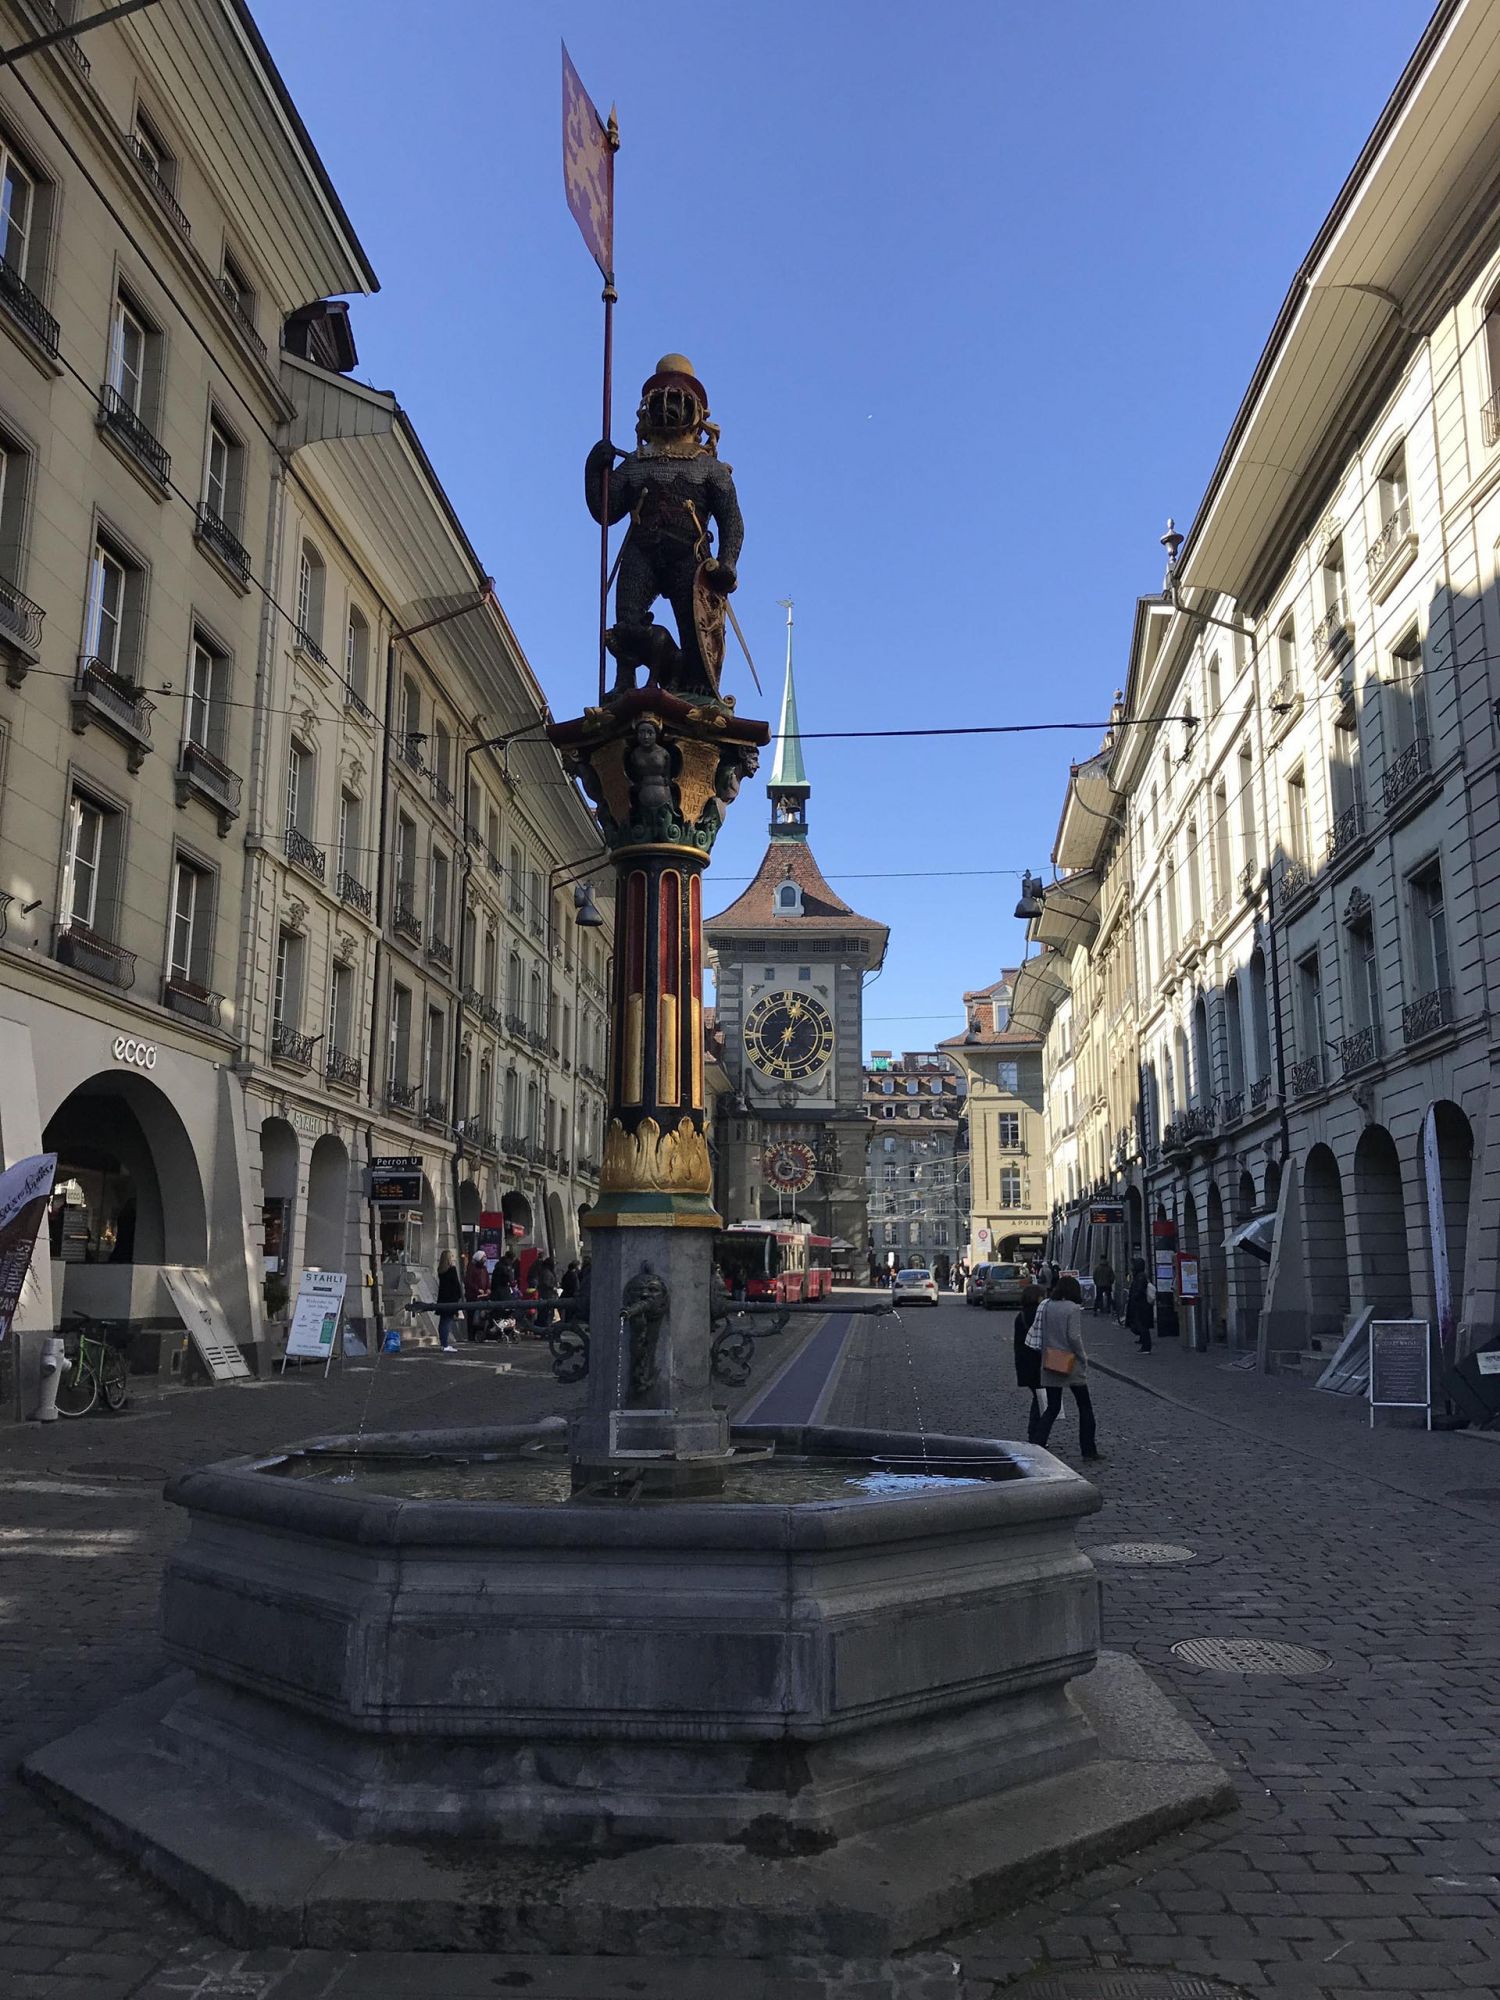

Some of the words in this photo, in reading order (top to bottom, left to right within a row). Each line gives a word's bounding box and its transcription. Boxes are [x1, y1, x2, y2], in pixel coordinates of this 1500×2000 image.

[113, 1036, 156, 1069] ecco
[376, 1158, 408, 1166] Perron
[411, 1157, 418, 1165] U
